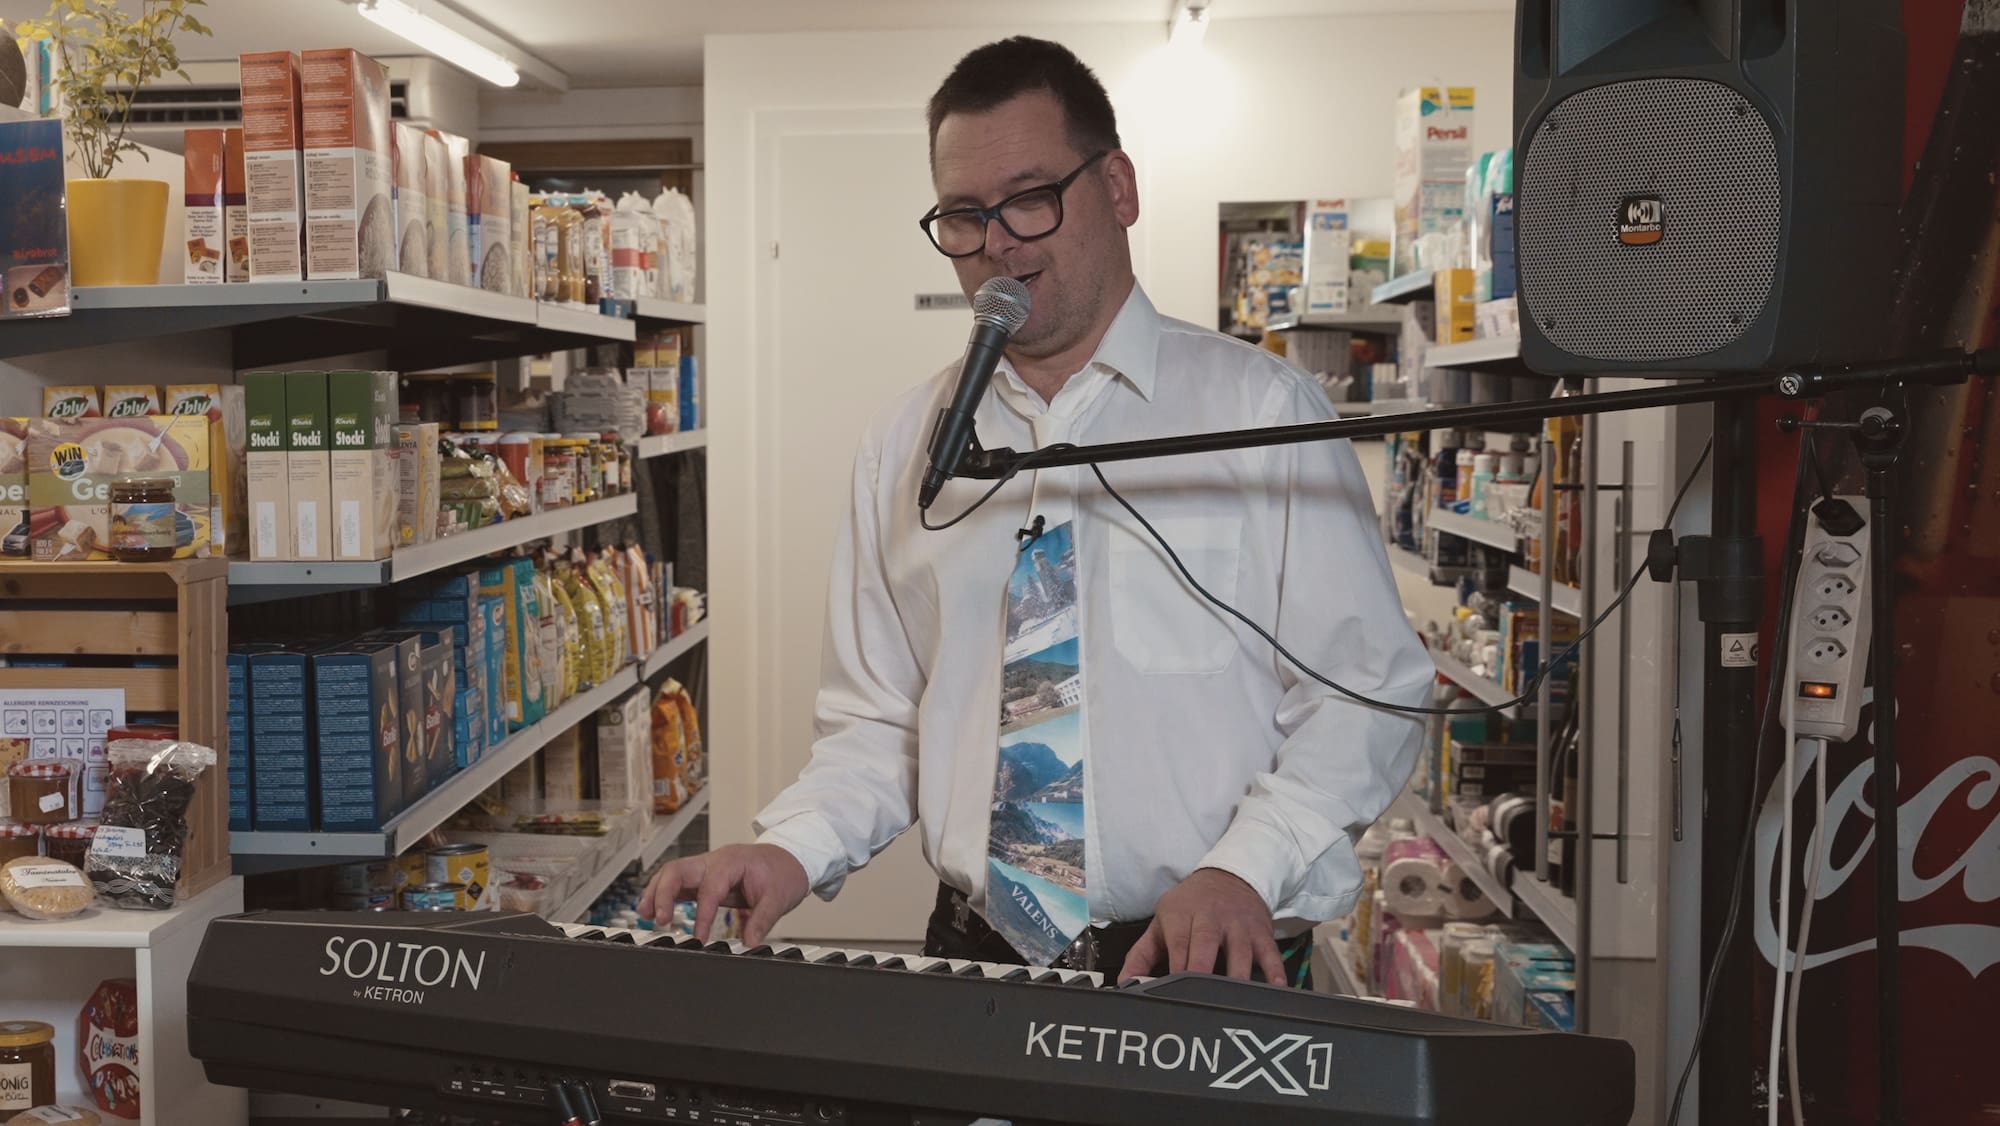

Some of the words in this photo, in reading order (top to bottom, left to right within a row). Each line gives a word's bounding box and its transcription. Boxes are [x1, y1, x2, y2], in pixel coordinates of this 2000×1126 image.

[1427, 126, 1467, 140] Persil
[1620, 224, 1661, 233] Montarbo
[53, 399, 89, 418] Ebly
[112, 399, 150, 417] Ebly
[174, 398, 211, 417] Ebly
[251, 430, 280, 447] Stocki
[292, 430, 321, 446] Stocki
[336, 429, 365, 446] Stocki
[53, 447, 82, 466] WIN
[71, 478, 109, 500] Ge
[1012, 884, 1059, 939] VALENS
[320, 936, 486, 991] SOLTON
[364, 985, 425, 1005] KETRON
[1025, 1021, 1222, 1074] KETRON
[1208, 1027, 1334, 1097] X1
[0, 1077, 29, 1091] ONIG
